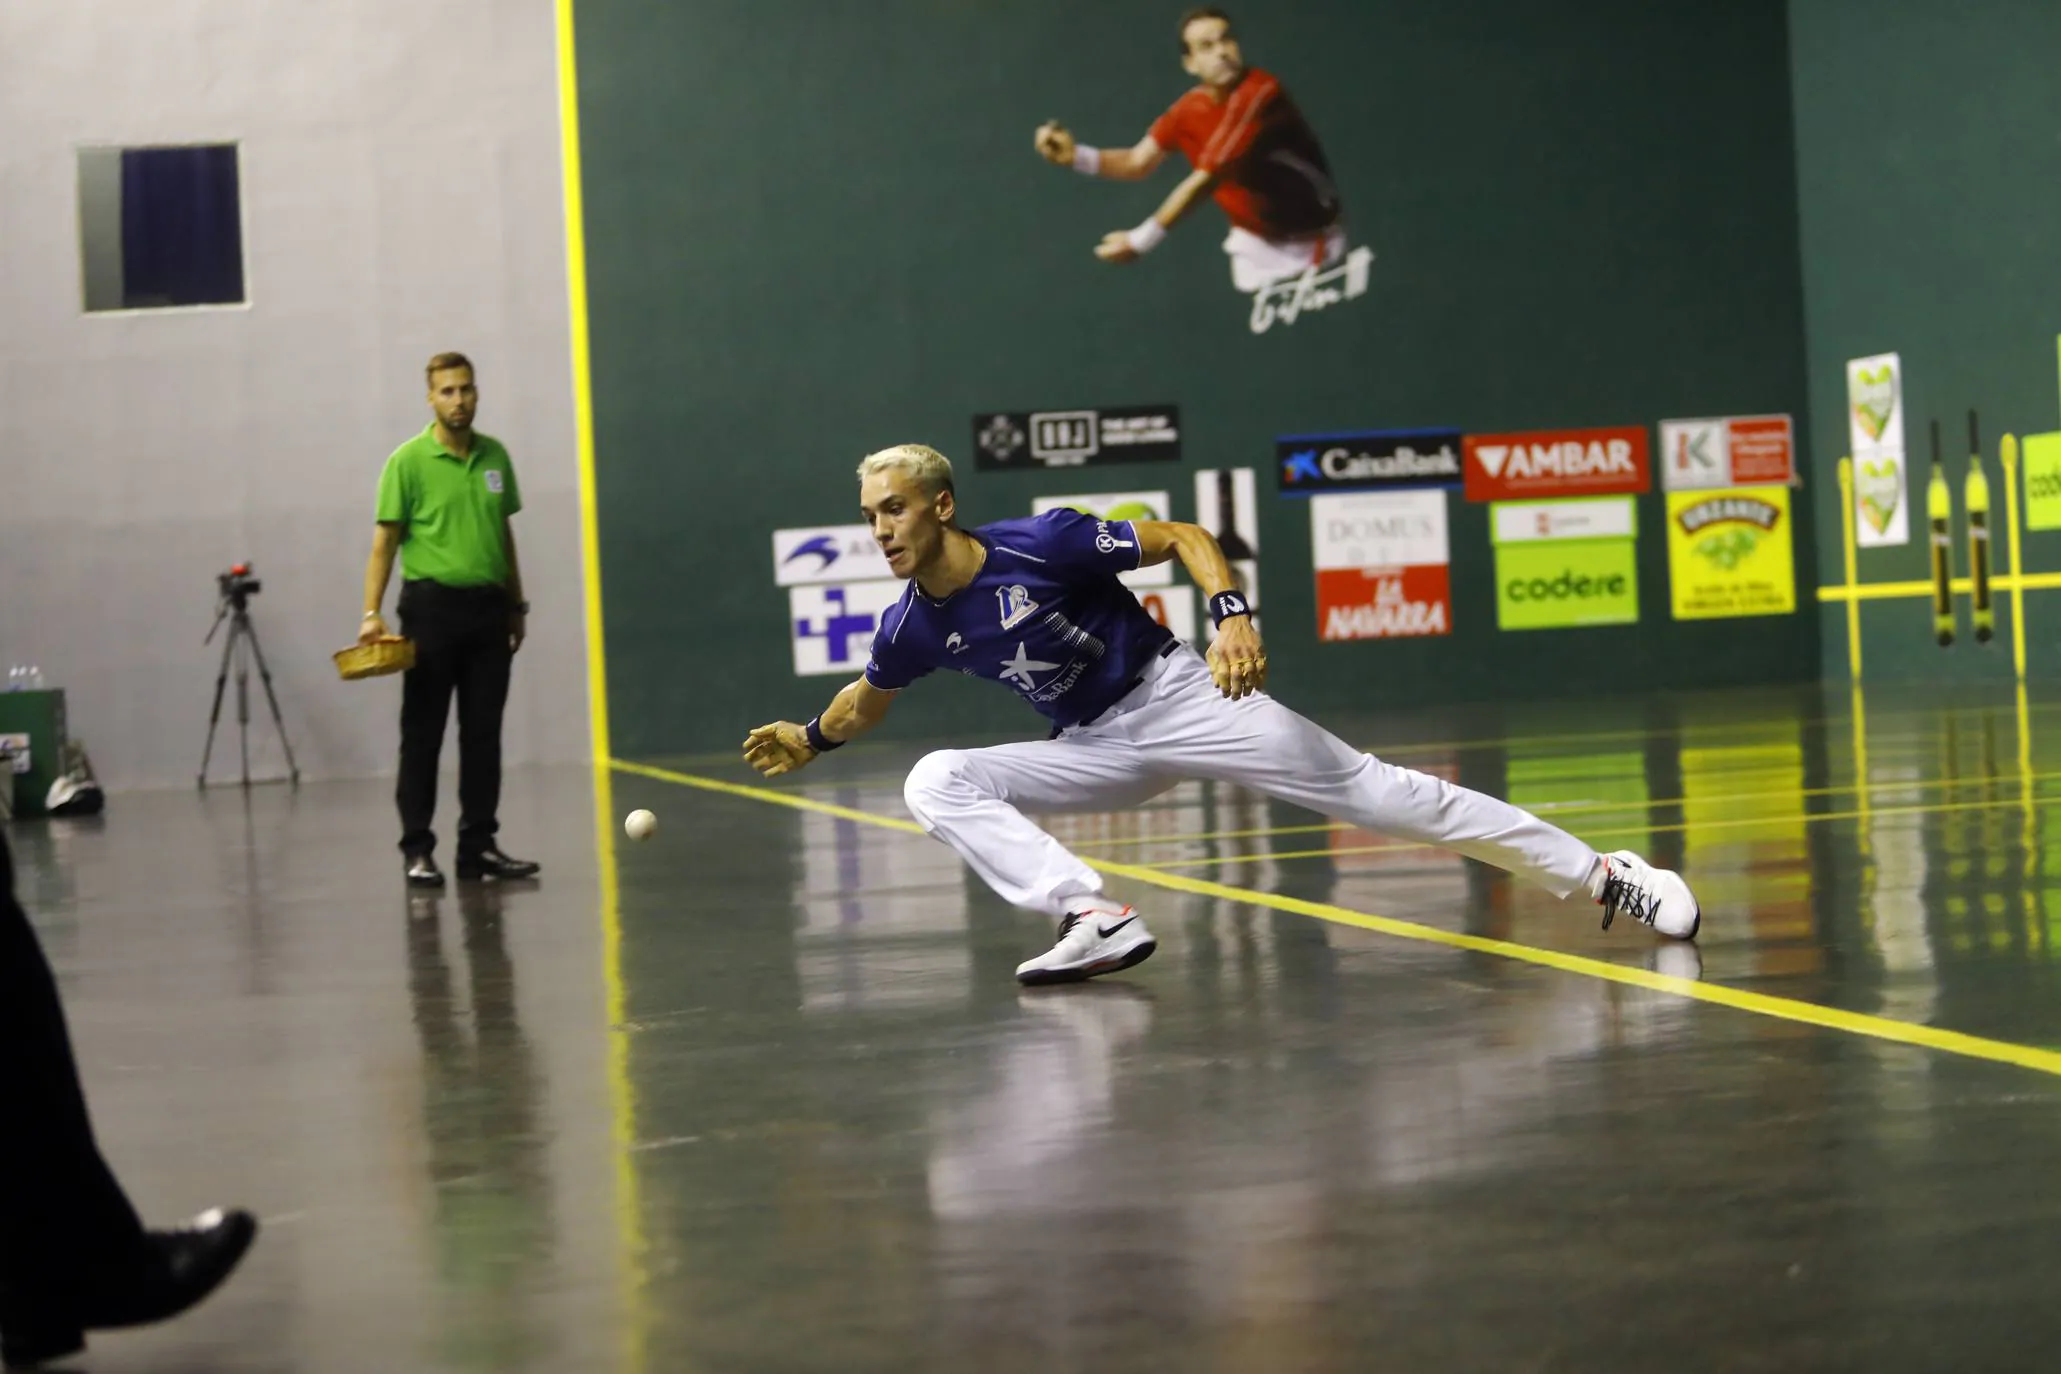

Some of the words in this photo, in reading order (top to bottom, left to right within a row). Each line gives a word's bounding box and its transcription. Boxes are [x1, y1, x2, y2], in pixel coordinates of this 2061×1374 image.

[1321, 444, 1460, 480] CaixaBank
[1505, 438, 1637, 479] AMBAR
[1507, 569, 1626, 604] codere
[1324, 601, 1447, 640] NAVARRA
